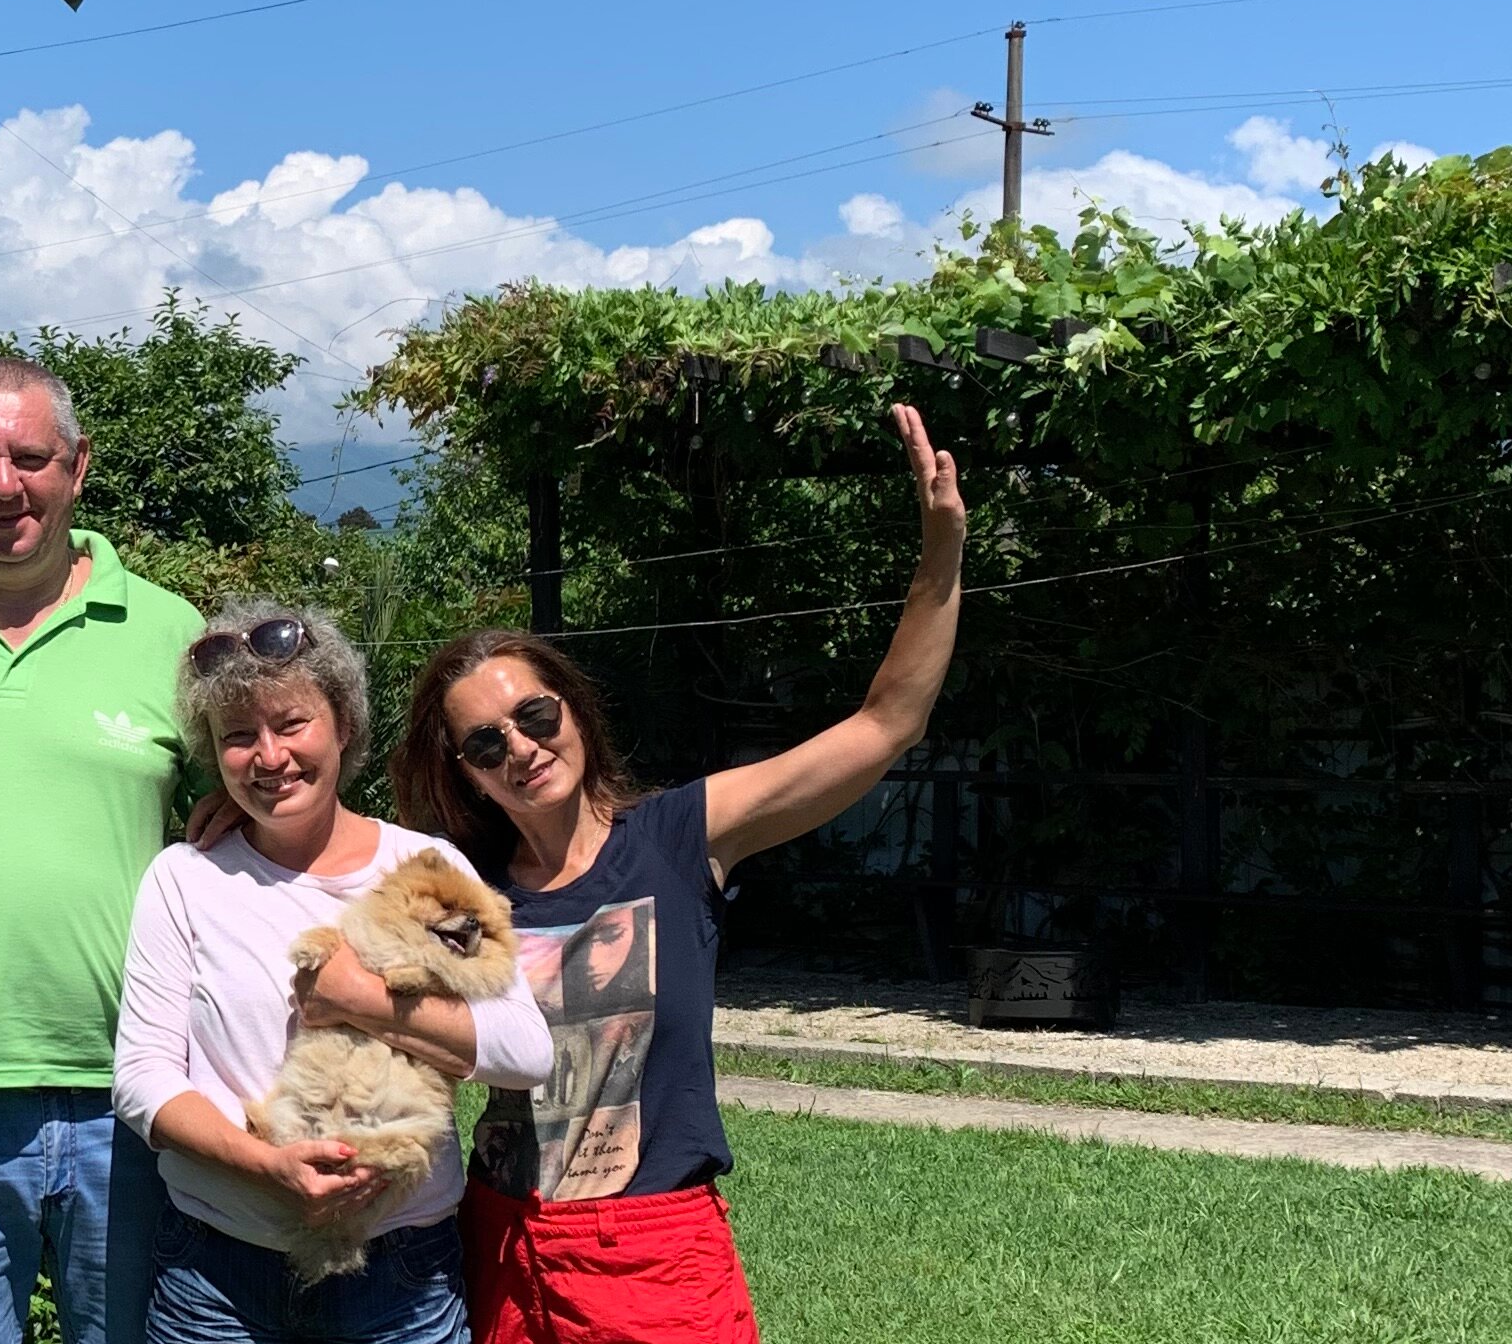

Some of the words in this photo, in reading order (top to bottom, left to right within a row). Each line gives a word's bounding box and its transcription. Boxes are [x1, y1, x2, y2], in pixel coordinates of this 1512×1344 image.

[98, 736, 146, 755] adidas
[593, 1142, 624, 1158] them
[603, 1164, 626, 1178] you
